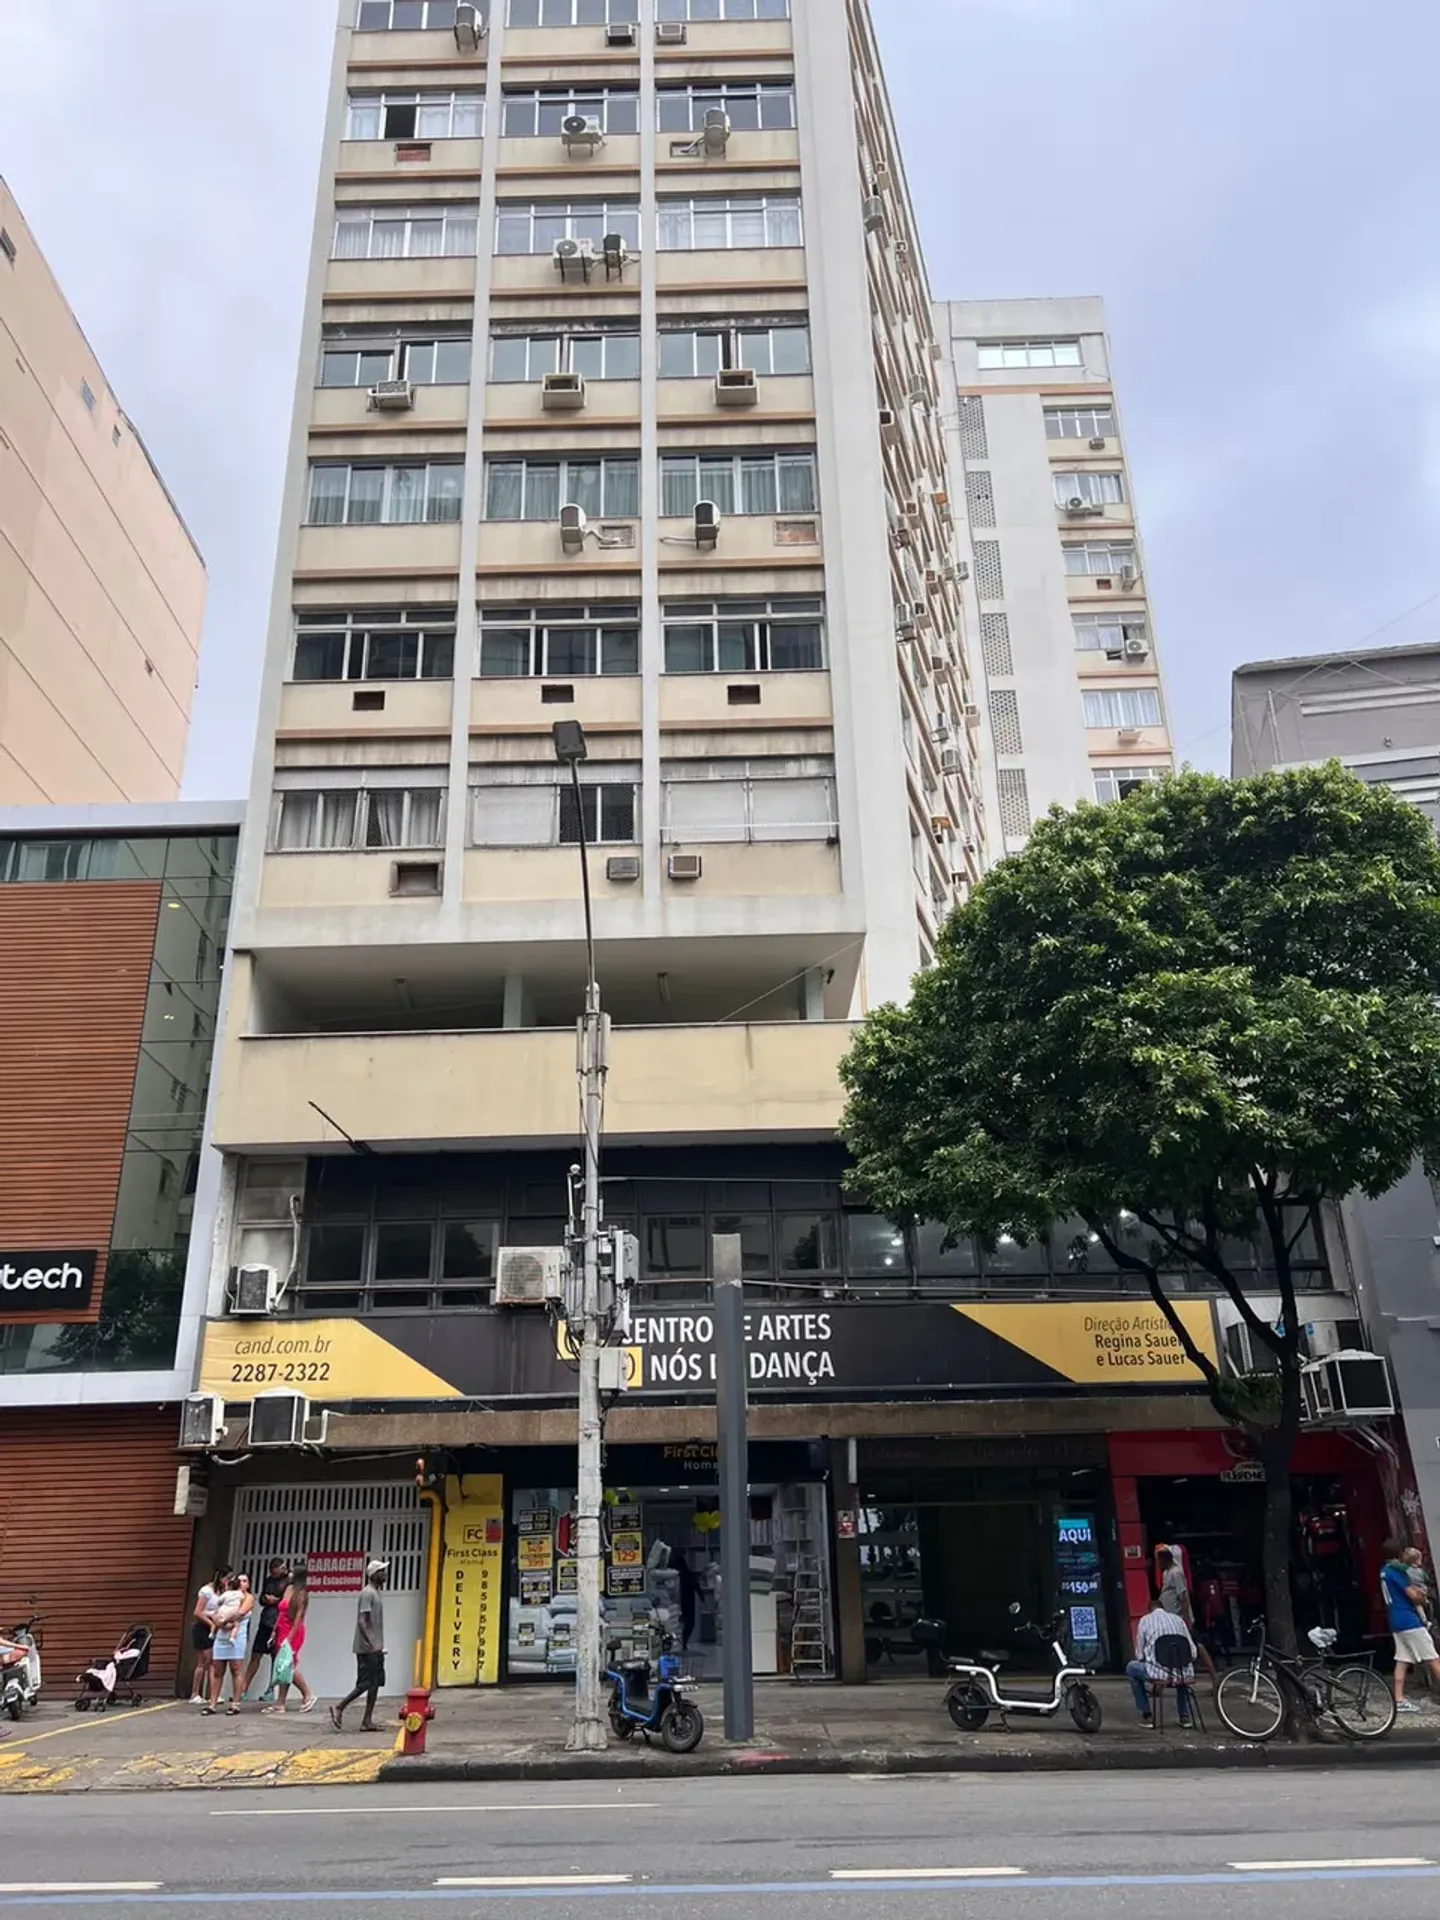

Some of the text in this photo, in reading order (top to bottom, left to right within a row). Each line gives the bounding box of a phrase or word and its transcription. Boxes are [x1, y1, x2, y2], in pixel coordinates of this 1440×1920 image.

[0, 1262, 83, 1290] tech
[744, 1315, 752, 1341] E
[758, 1314, 831, 1341] ARTES
[1084, 1316, 1168, 1335] Direção Artísti
[235, 1335, 332, 1355] cand.com.br
[1095, 1334, 1141, 1352] Regina
[651, 1348, 701, 1382] NÓS
[750, 1350, 835, 1385] DANÇA
[1096, 1350, 1185, 1366] e Lucas Sauer
[231, 1362, 330, 1382] 2287-2322
[467, 1529, 483, 1540] FC
[1059, 1528, 1092, 1544] AQUI
[447, 1548, 498, 1558] First Class
[617, 1552, 635, 1561] 129
[308, 1557, 363, 1572] GARAGEM
[452, 1570, 464, 1670] DELIVERY
